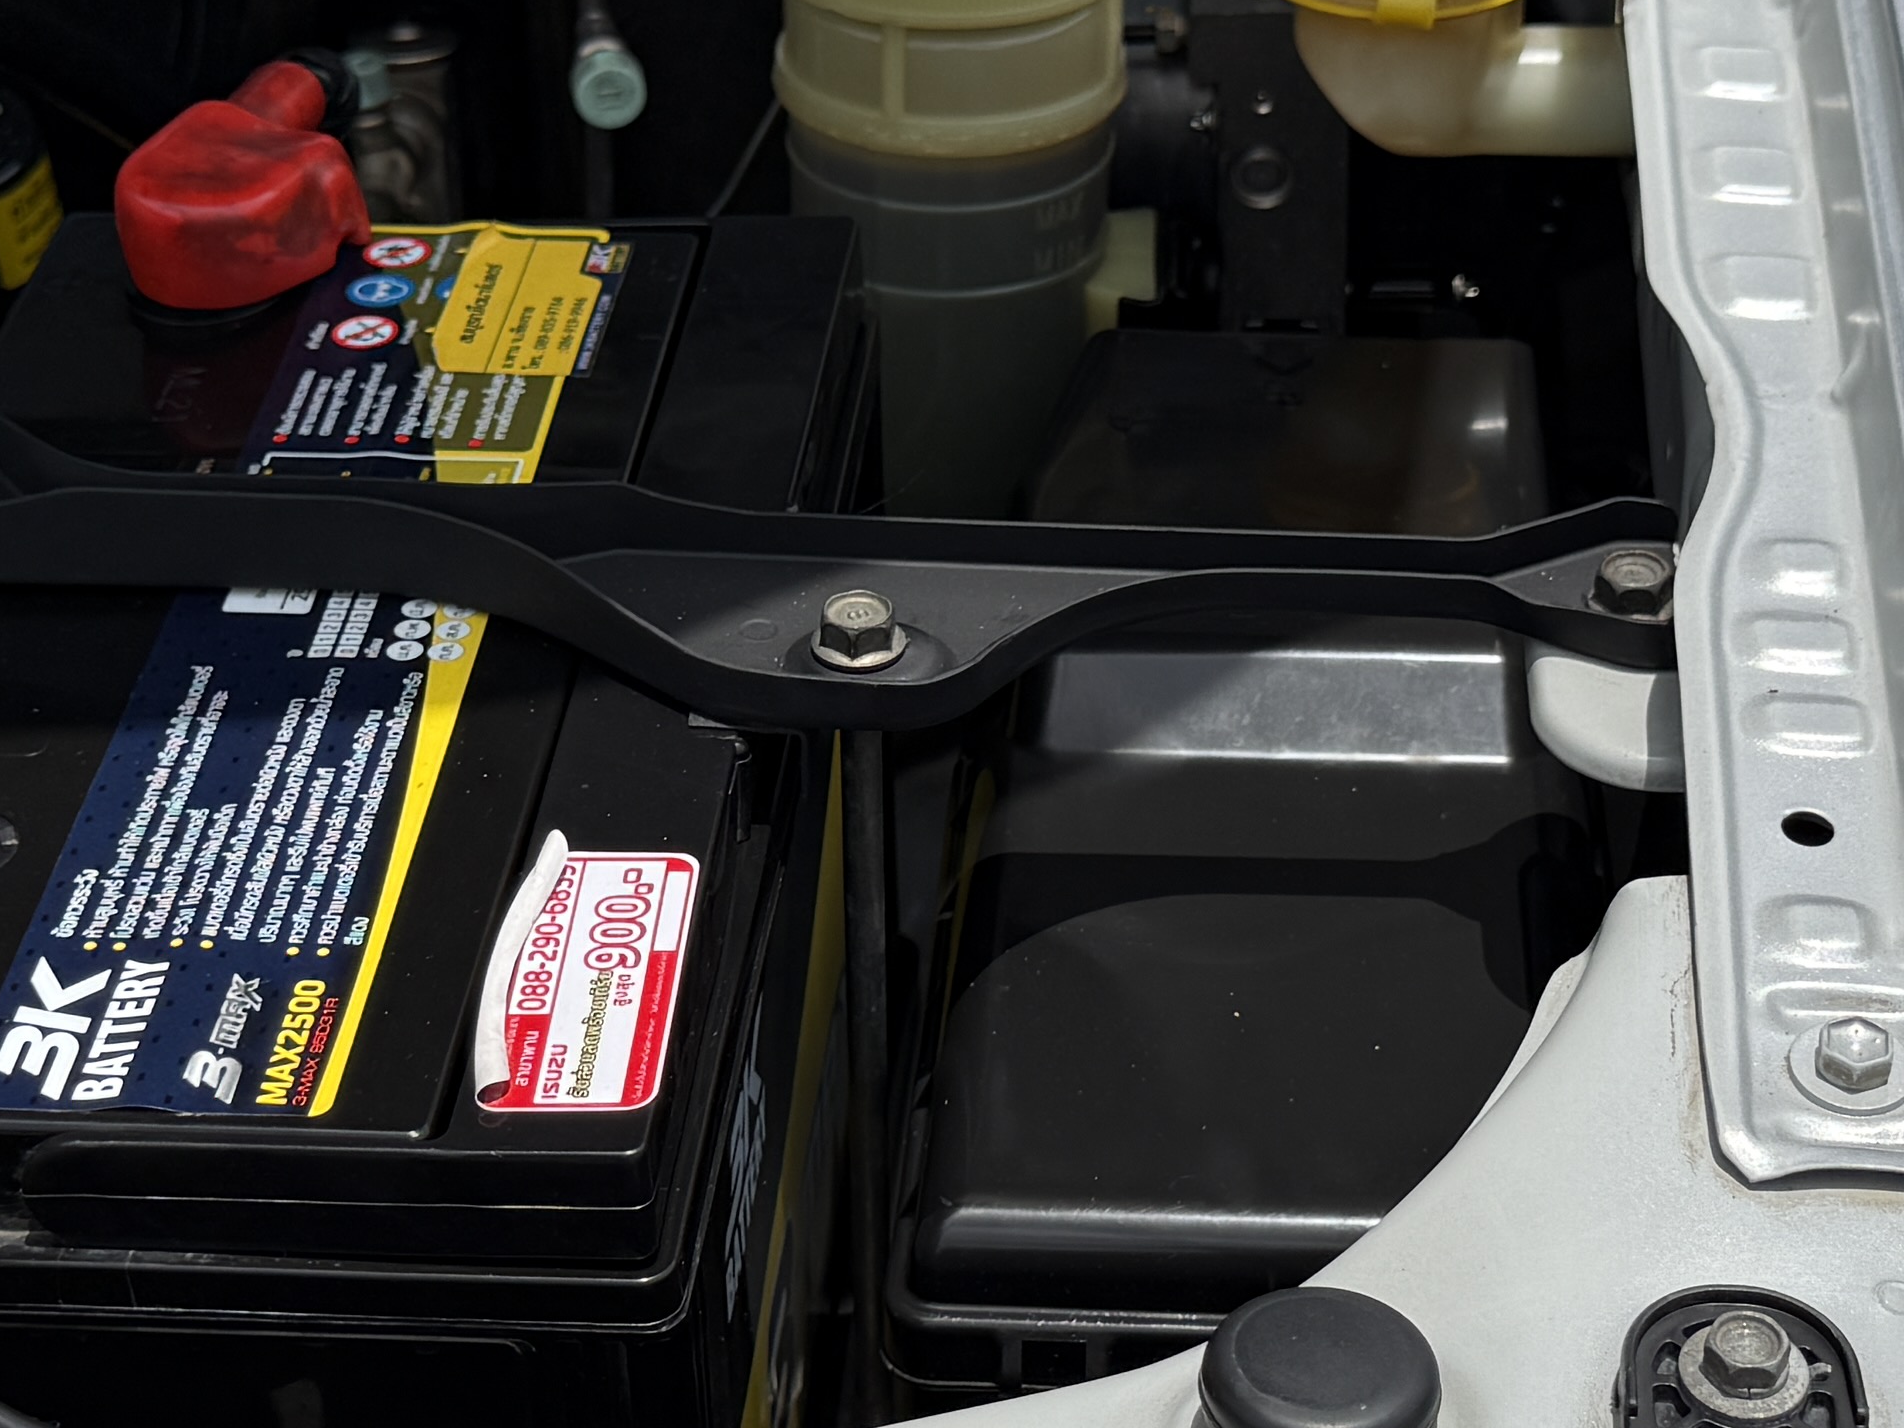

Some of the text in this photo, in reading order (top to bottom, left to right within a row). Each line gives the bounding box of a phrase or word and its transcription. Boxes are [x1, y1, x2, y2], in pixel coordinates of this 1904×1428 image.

[50, 869, 99, 937] ข้อควรระวัง
[584, 868, 654, 971] 900.-
[613, 975, 635, 1006] สูงสุด
[72, 960, 169, 1100] BATTERY
[256, 980, 325, 1104] MAX2500
[515, 1031, 539, 1086] สาขาพาน
[292, 1058, 320, 1106] 3-MAX
[542, 1045, 567, 1098] ISUZU
